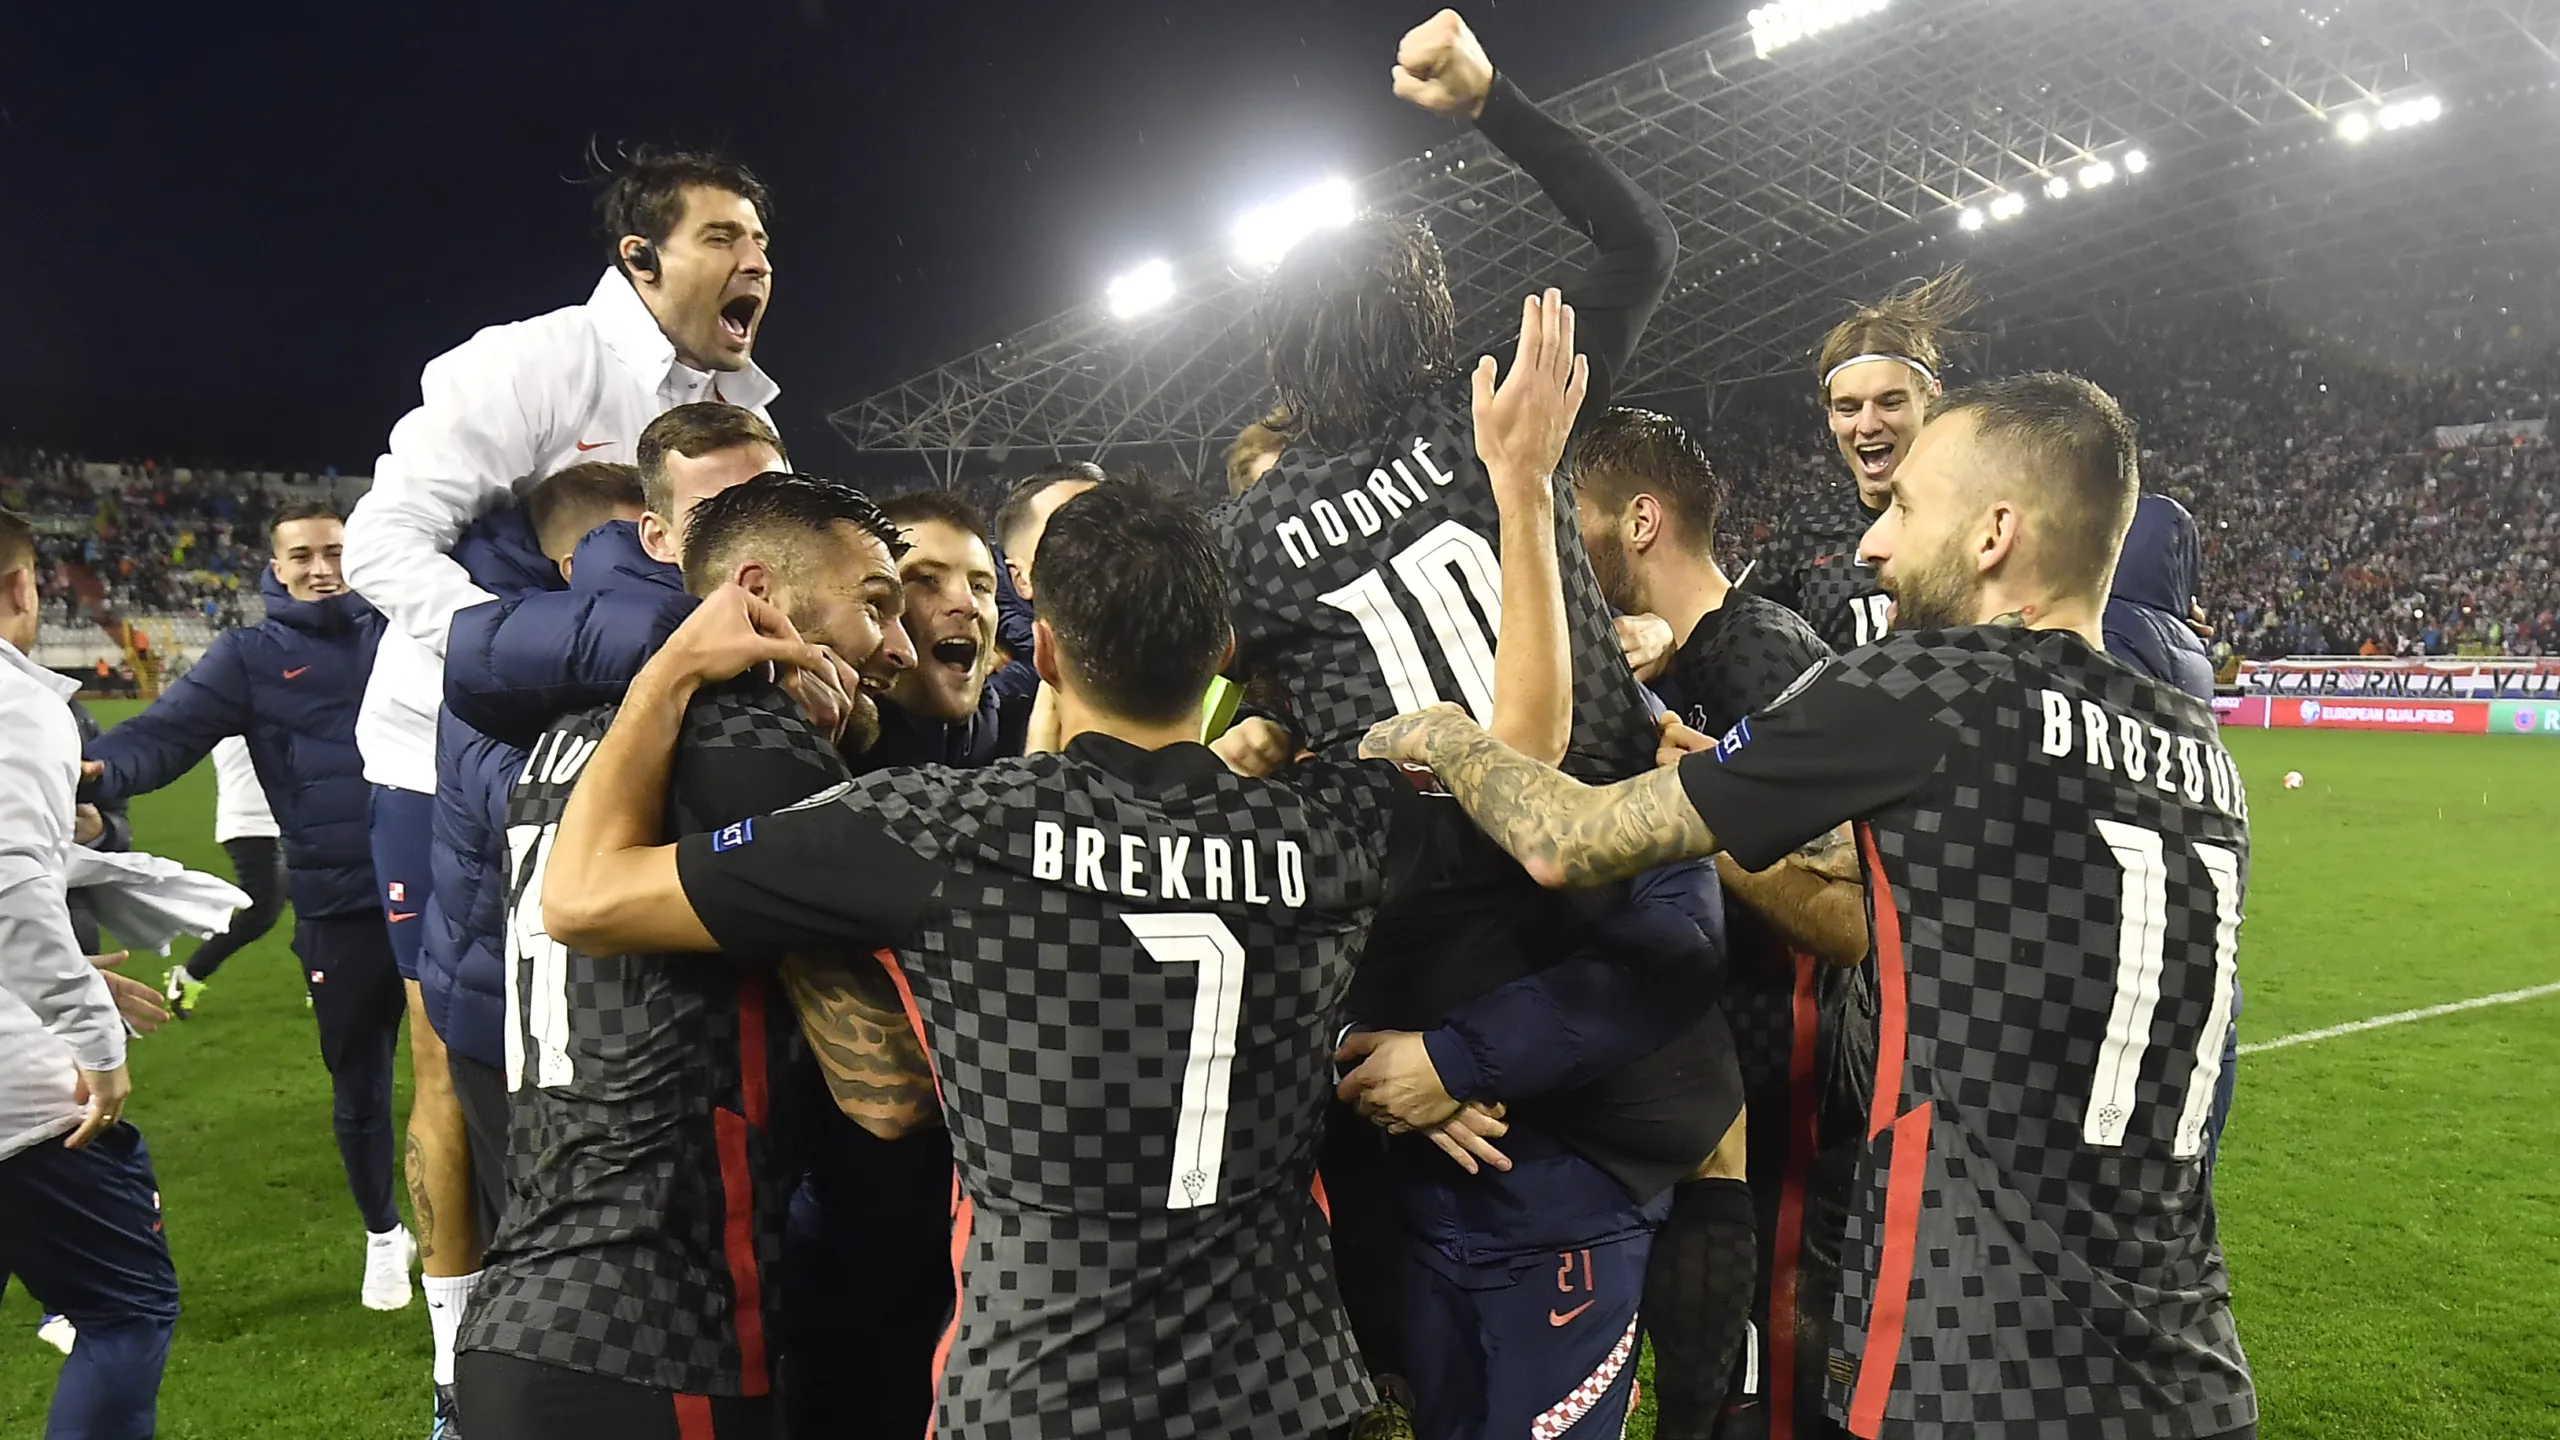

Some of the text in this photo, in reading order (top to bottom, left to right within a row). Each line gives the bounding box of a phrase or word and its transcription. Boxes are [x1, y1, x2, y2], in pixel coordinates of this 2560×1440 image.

[1275, 436, 1454, 568] MODRIĆ
[1316, 519, 1502, 732] 10
[2322, 706, 2455, 725] EUROPEAN QUALIFIERS
[2492, 667, 2560, 698] VU
[1032, 820, 1306, 907] BREKALO
[2083, 818, 2243, 1159] 11
[1119, 912, 1246, 1210] 7
[1556, 1249, 1594, 1293] 21
